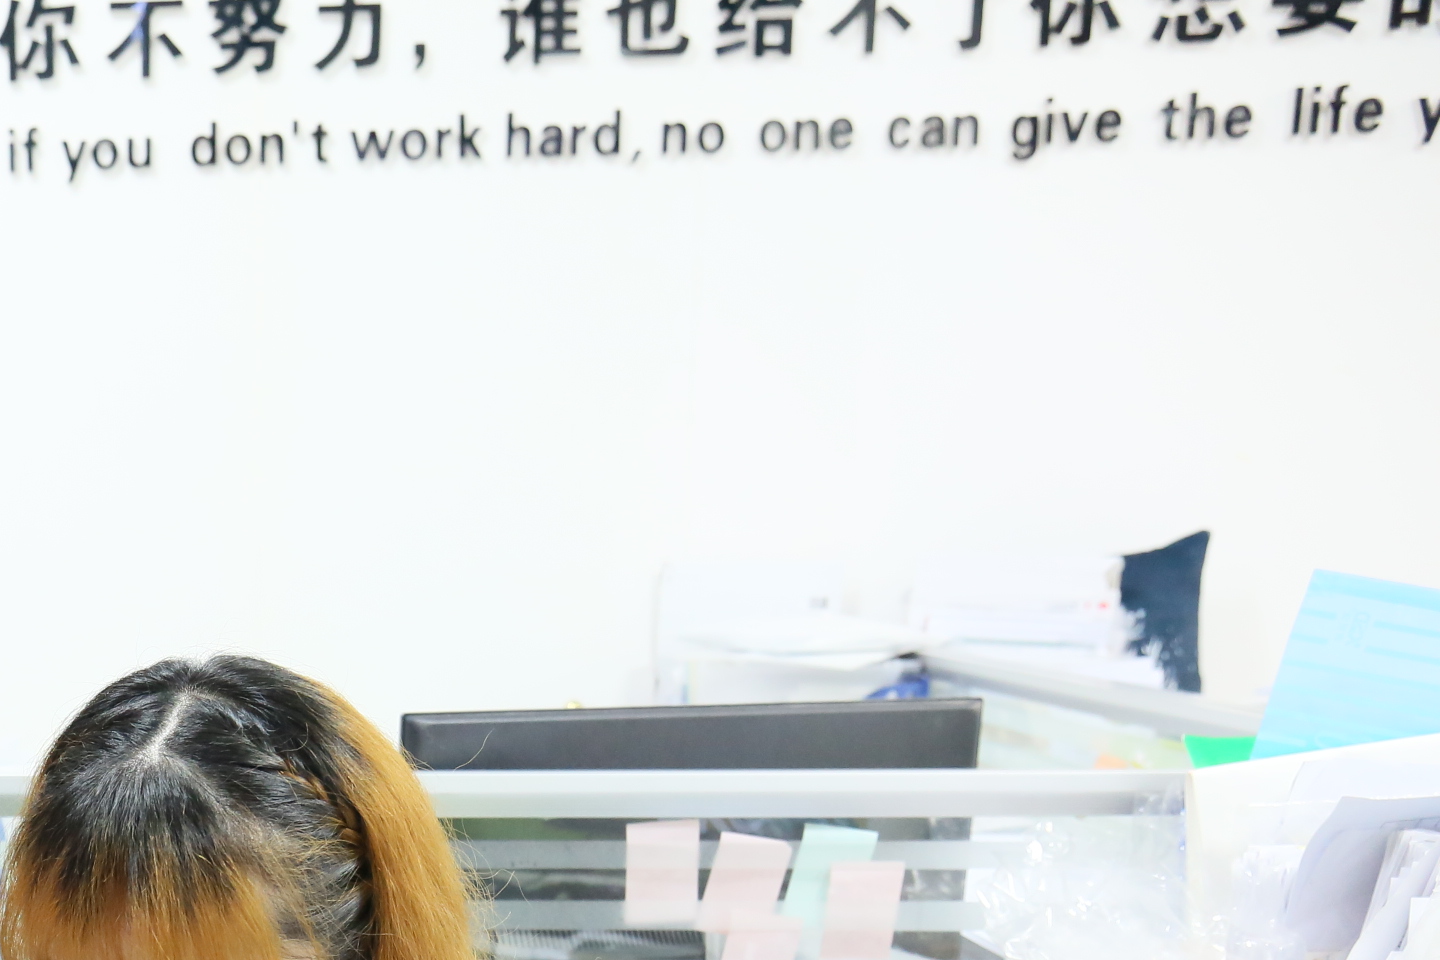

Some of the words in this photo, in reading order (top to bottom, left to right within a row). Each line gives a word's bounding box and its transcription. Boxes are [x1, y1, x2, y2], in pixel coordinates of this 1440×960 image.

[8, 127, 38, 173] if
[63, 137, 152, 182] you
[191, 120, 328, 167] don't
[351, 114, 482, 161] work
[506, 109, 643, 166] hard,
[662, 121, 726, 155] no
[760, 117, 854, 153] one
[888, 115, 980, 149] can
[1011, 98, 1123, 161] give
[1161, 93, 1254, 141] the
[1291, 84, 1385, 136] life
